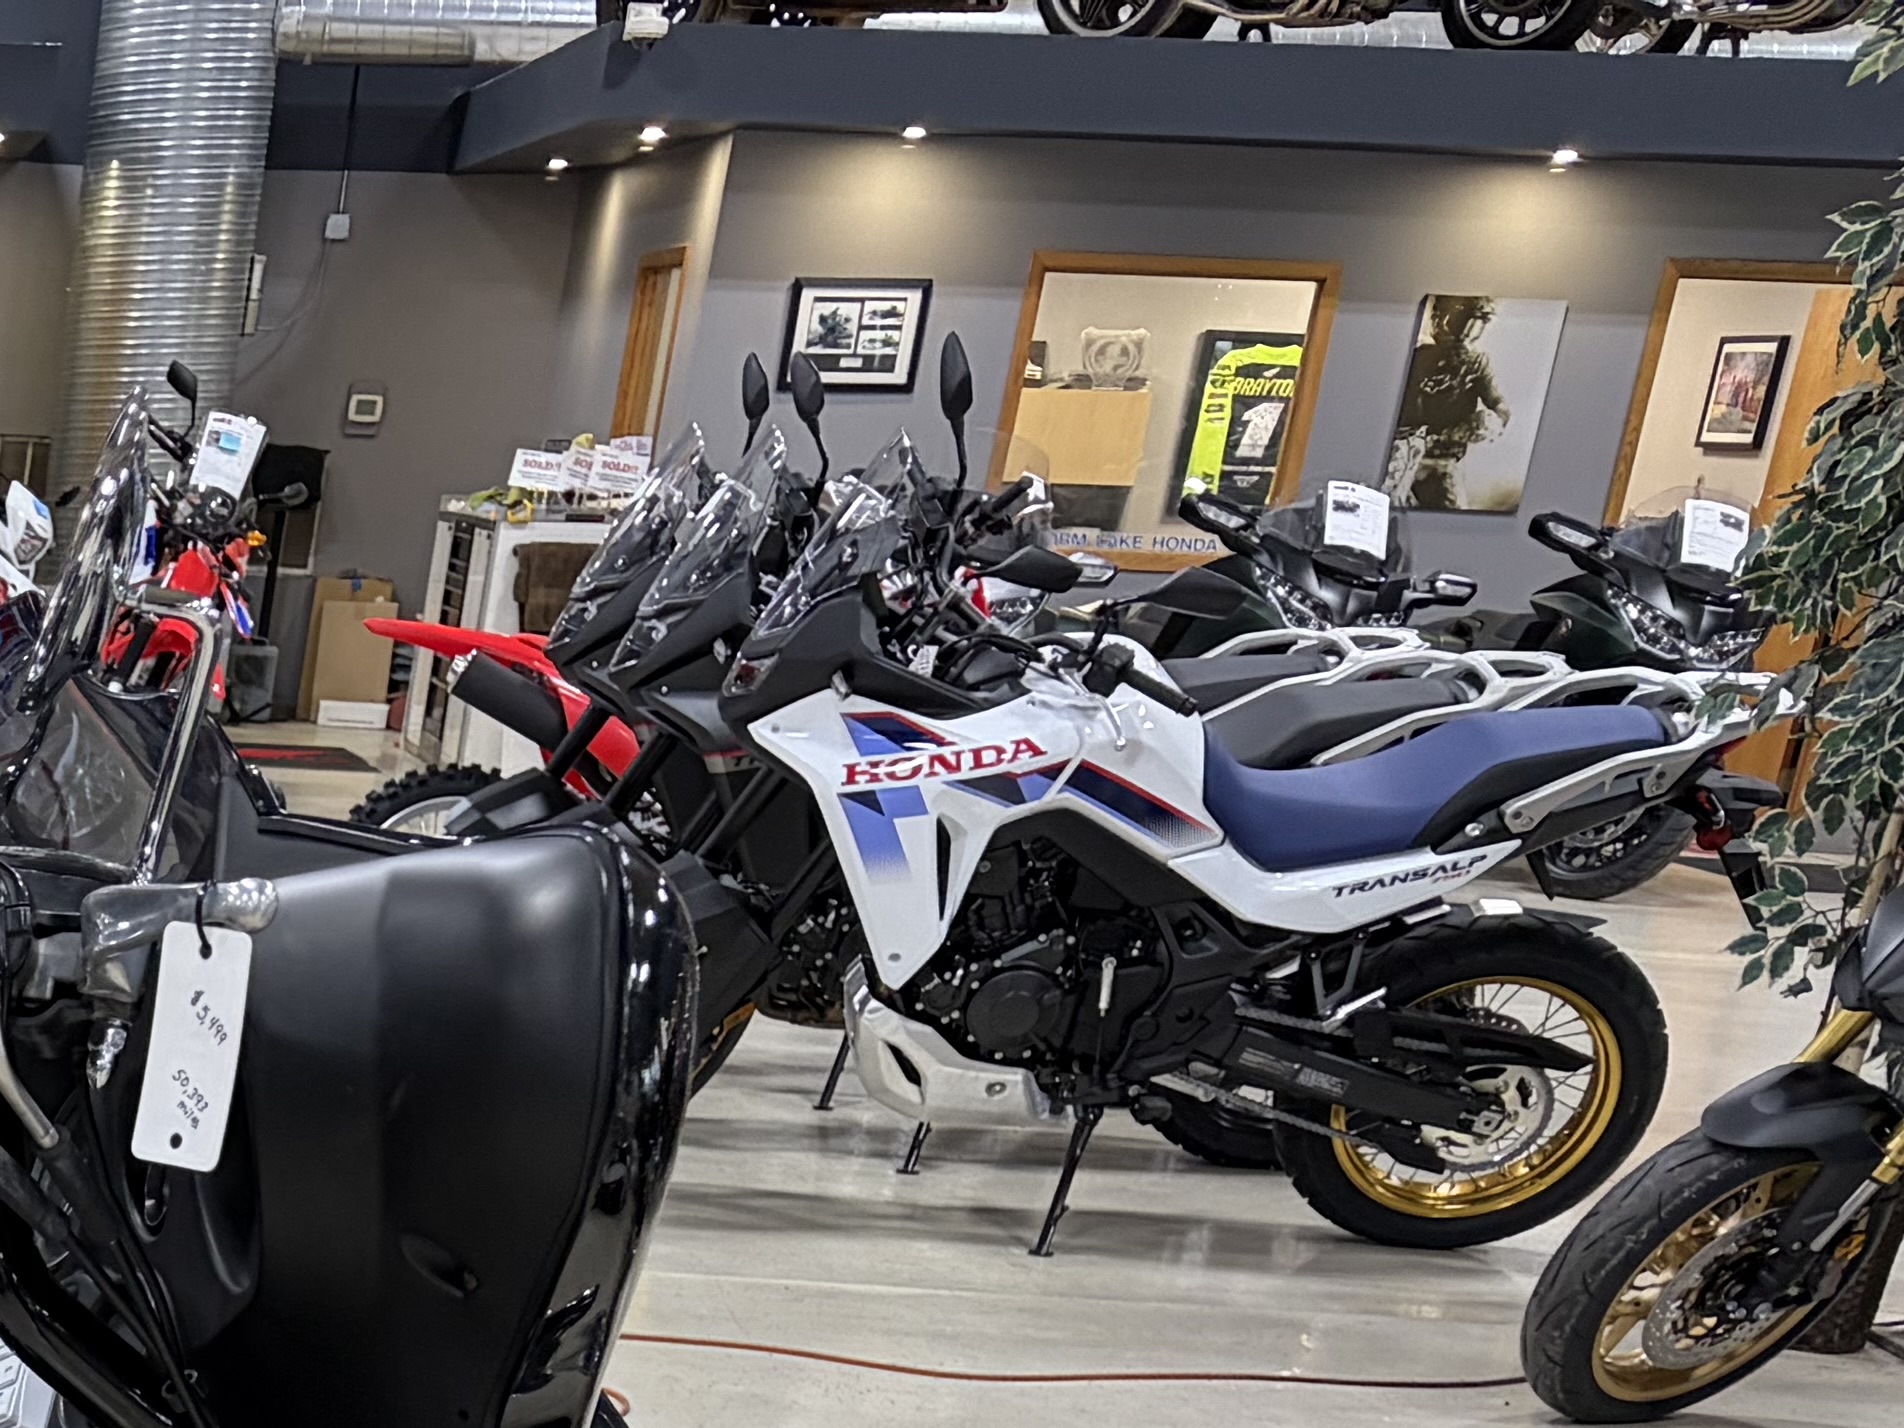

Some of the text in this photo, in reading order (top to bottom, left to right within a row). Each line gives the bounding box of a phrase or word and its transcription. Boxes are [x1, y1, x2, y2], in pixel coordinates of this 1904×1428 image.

[1152, 535, 1218, 551] HONDA
[841, 737, 1048, 787] HONDA
[1332, 854, 1487, 899] TRANSALP
